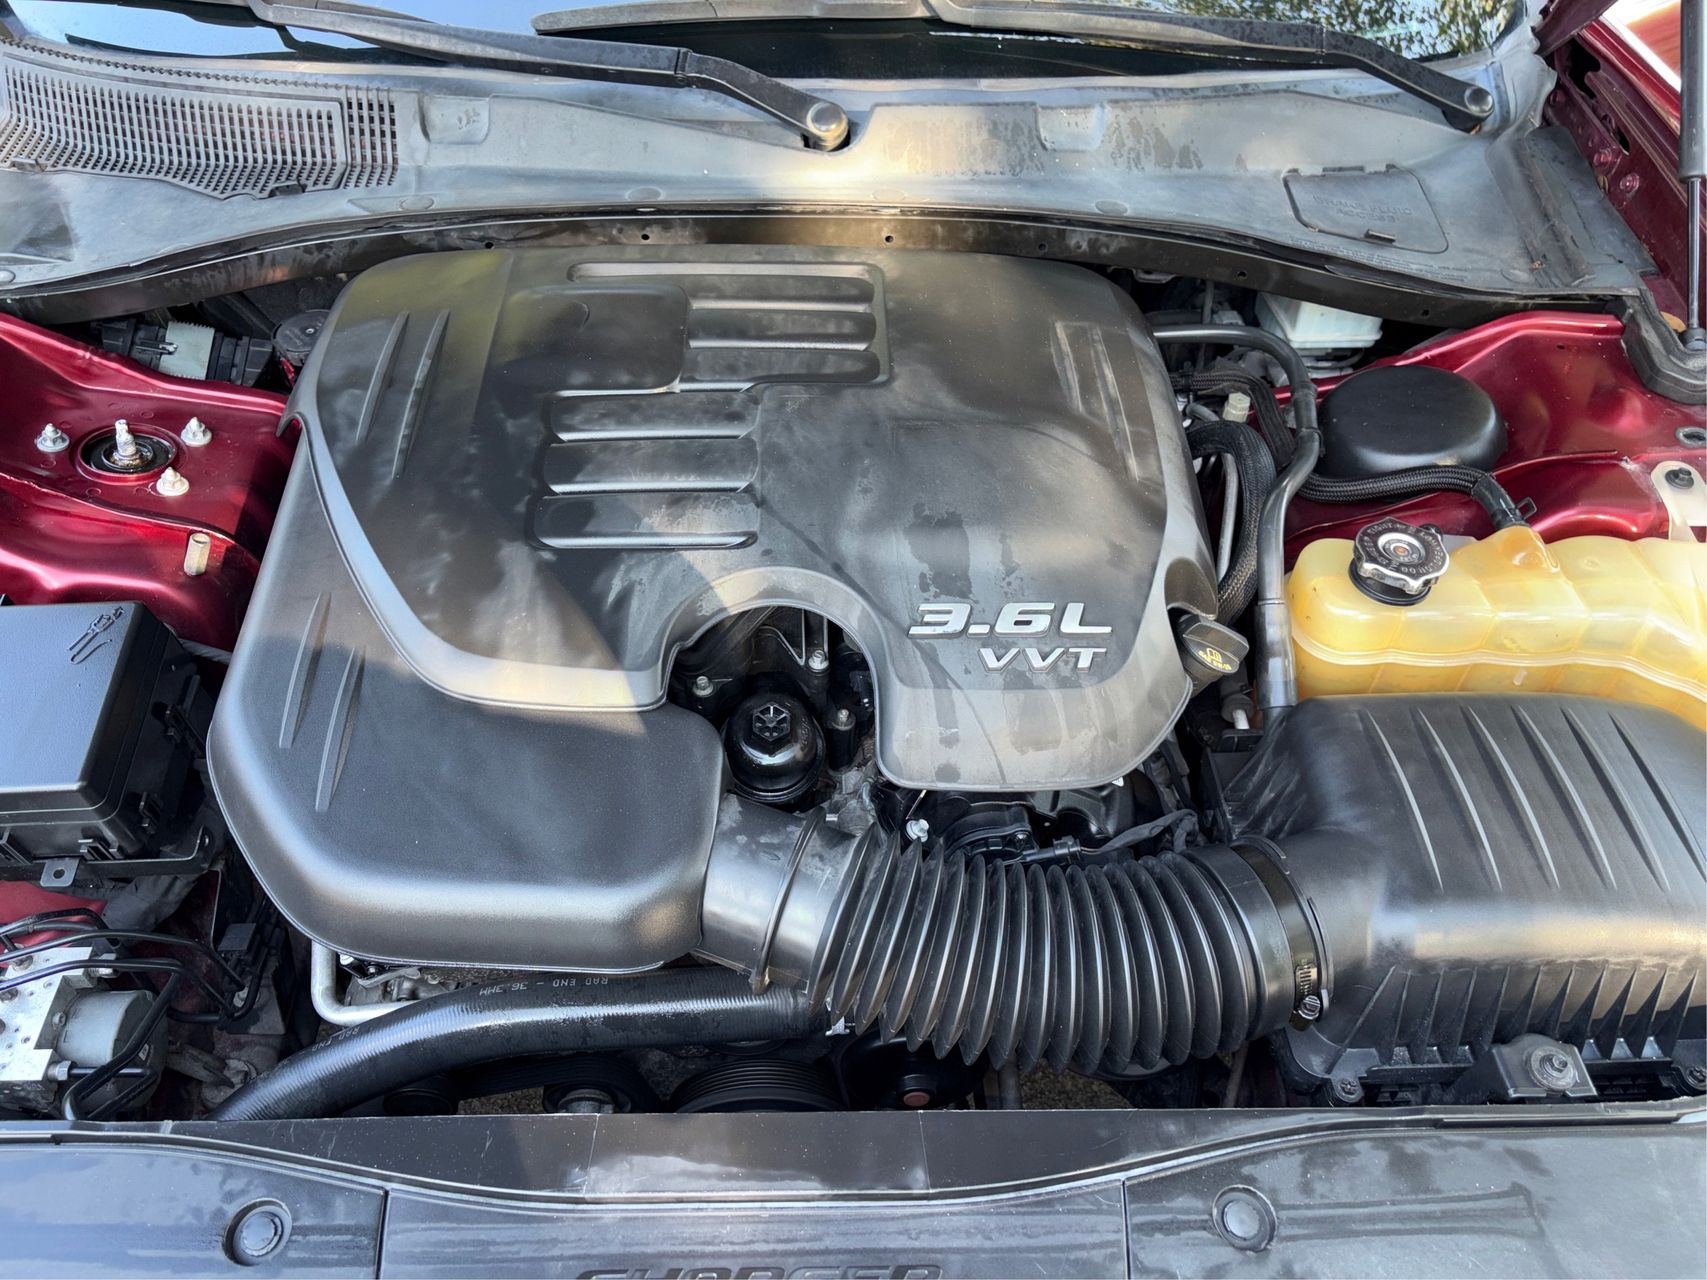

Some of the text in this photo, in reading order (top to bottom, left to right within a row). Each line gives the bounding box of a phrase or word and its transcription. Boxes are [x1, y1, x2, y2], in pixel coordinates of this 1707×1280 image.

[1368, 204, 1413, 217] FLUID
[907, 602, 1113, 638] 3.6L
[977, 647, 1108, 673] VVT
[552, 978, 577, 988] END
[585, 976, 609, 985] RAD
